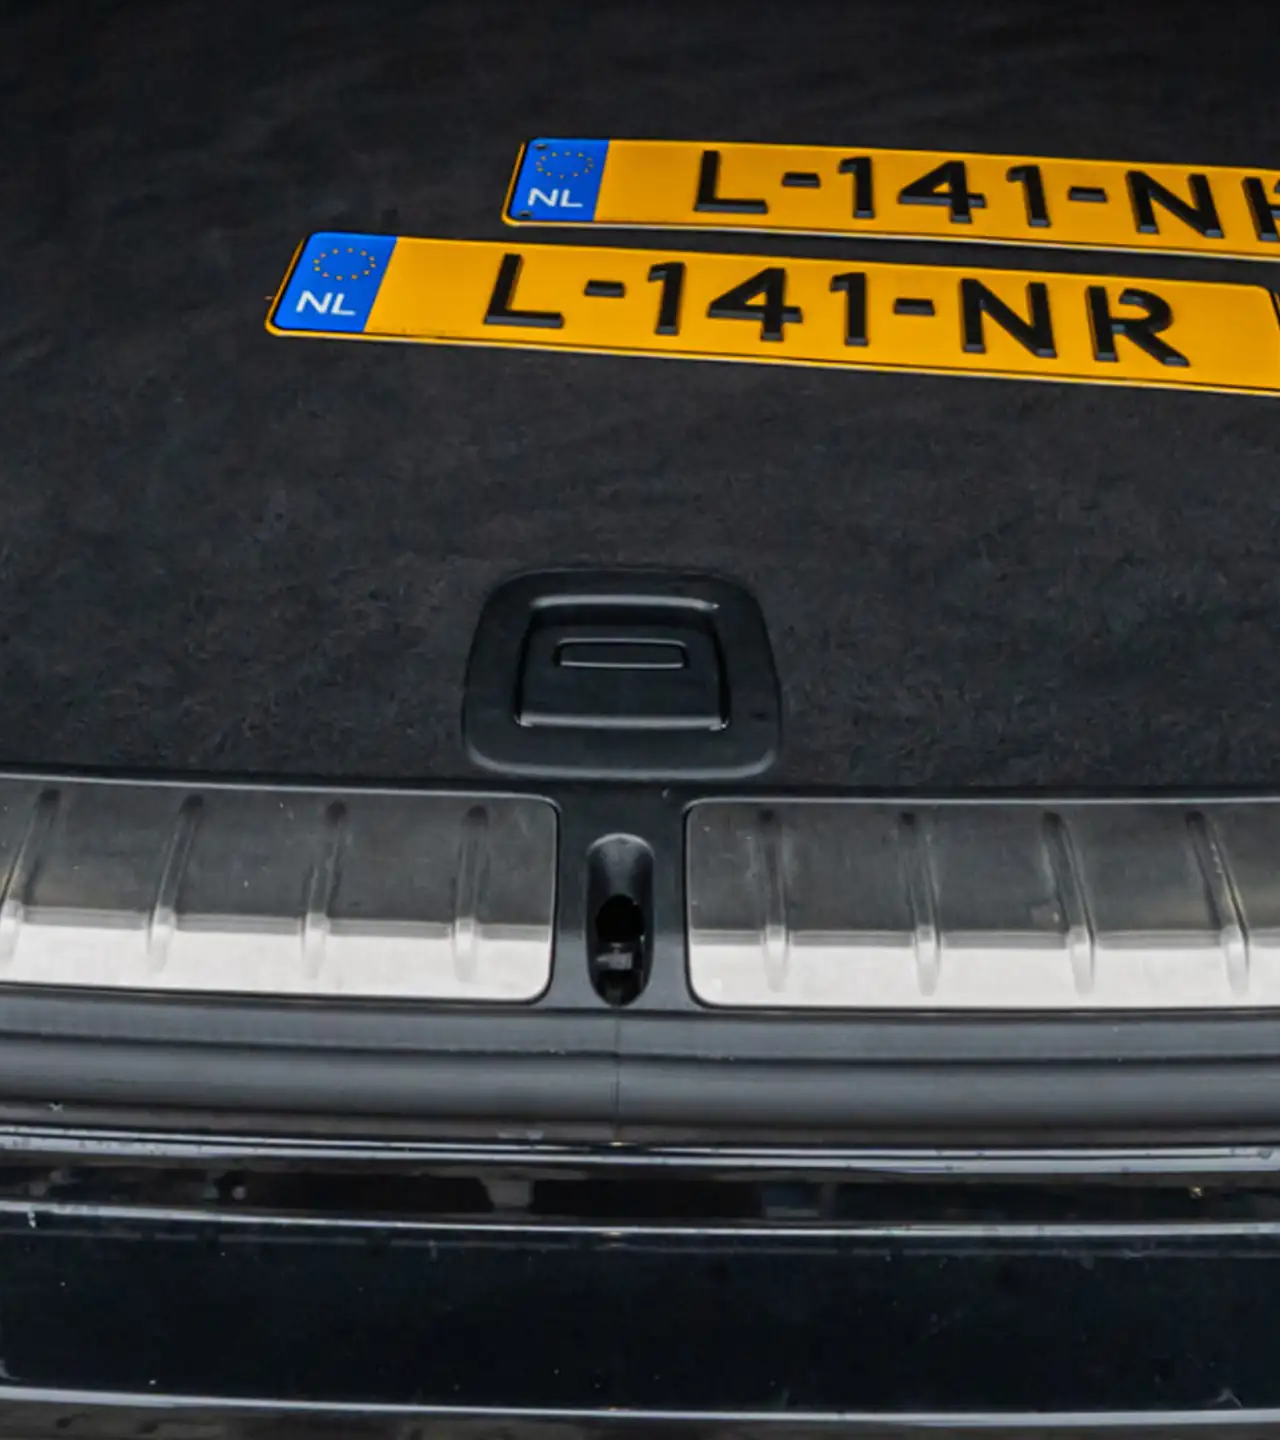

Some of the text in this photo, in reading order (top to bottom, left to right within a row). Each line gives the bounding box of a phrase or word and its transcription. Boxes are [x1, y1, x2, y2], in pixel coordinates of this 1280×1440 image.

[527, 187, 583, 209] NL
[295, 252, 1190, 368] NL L-141-NR
